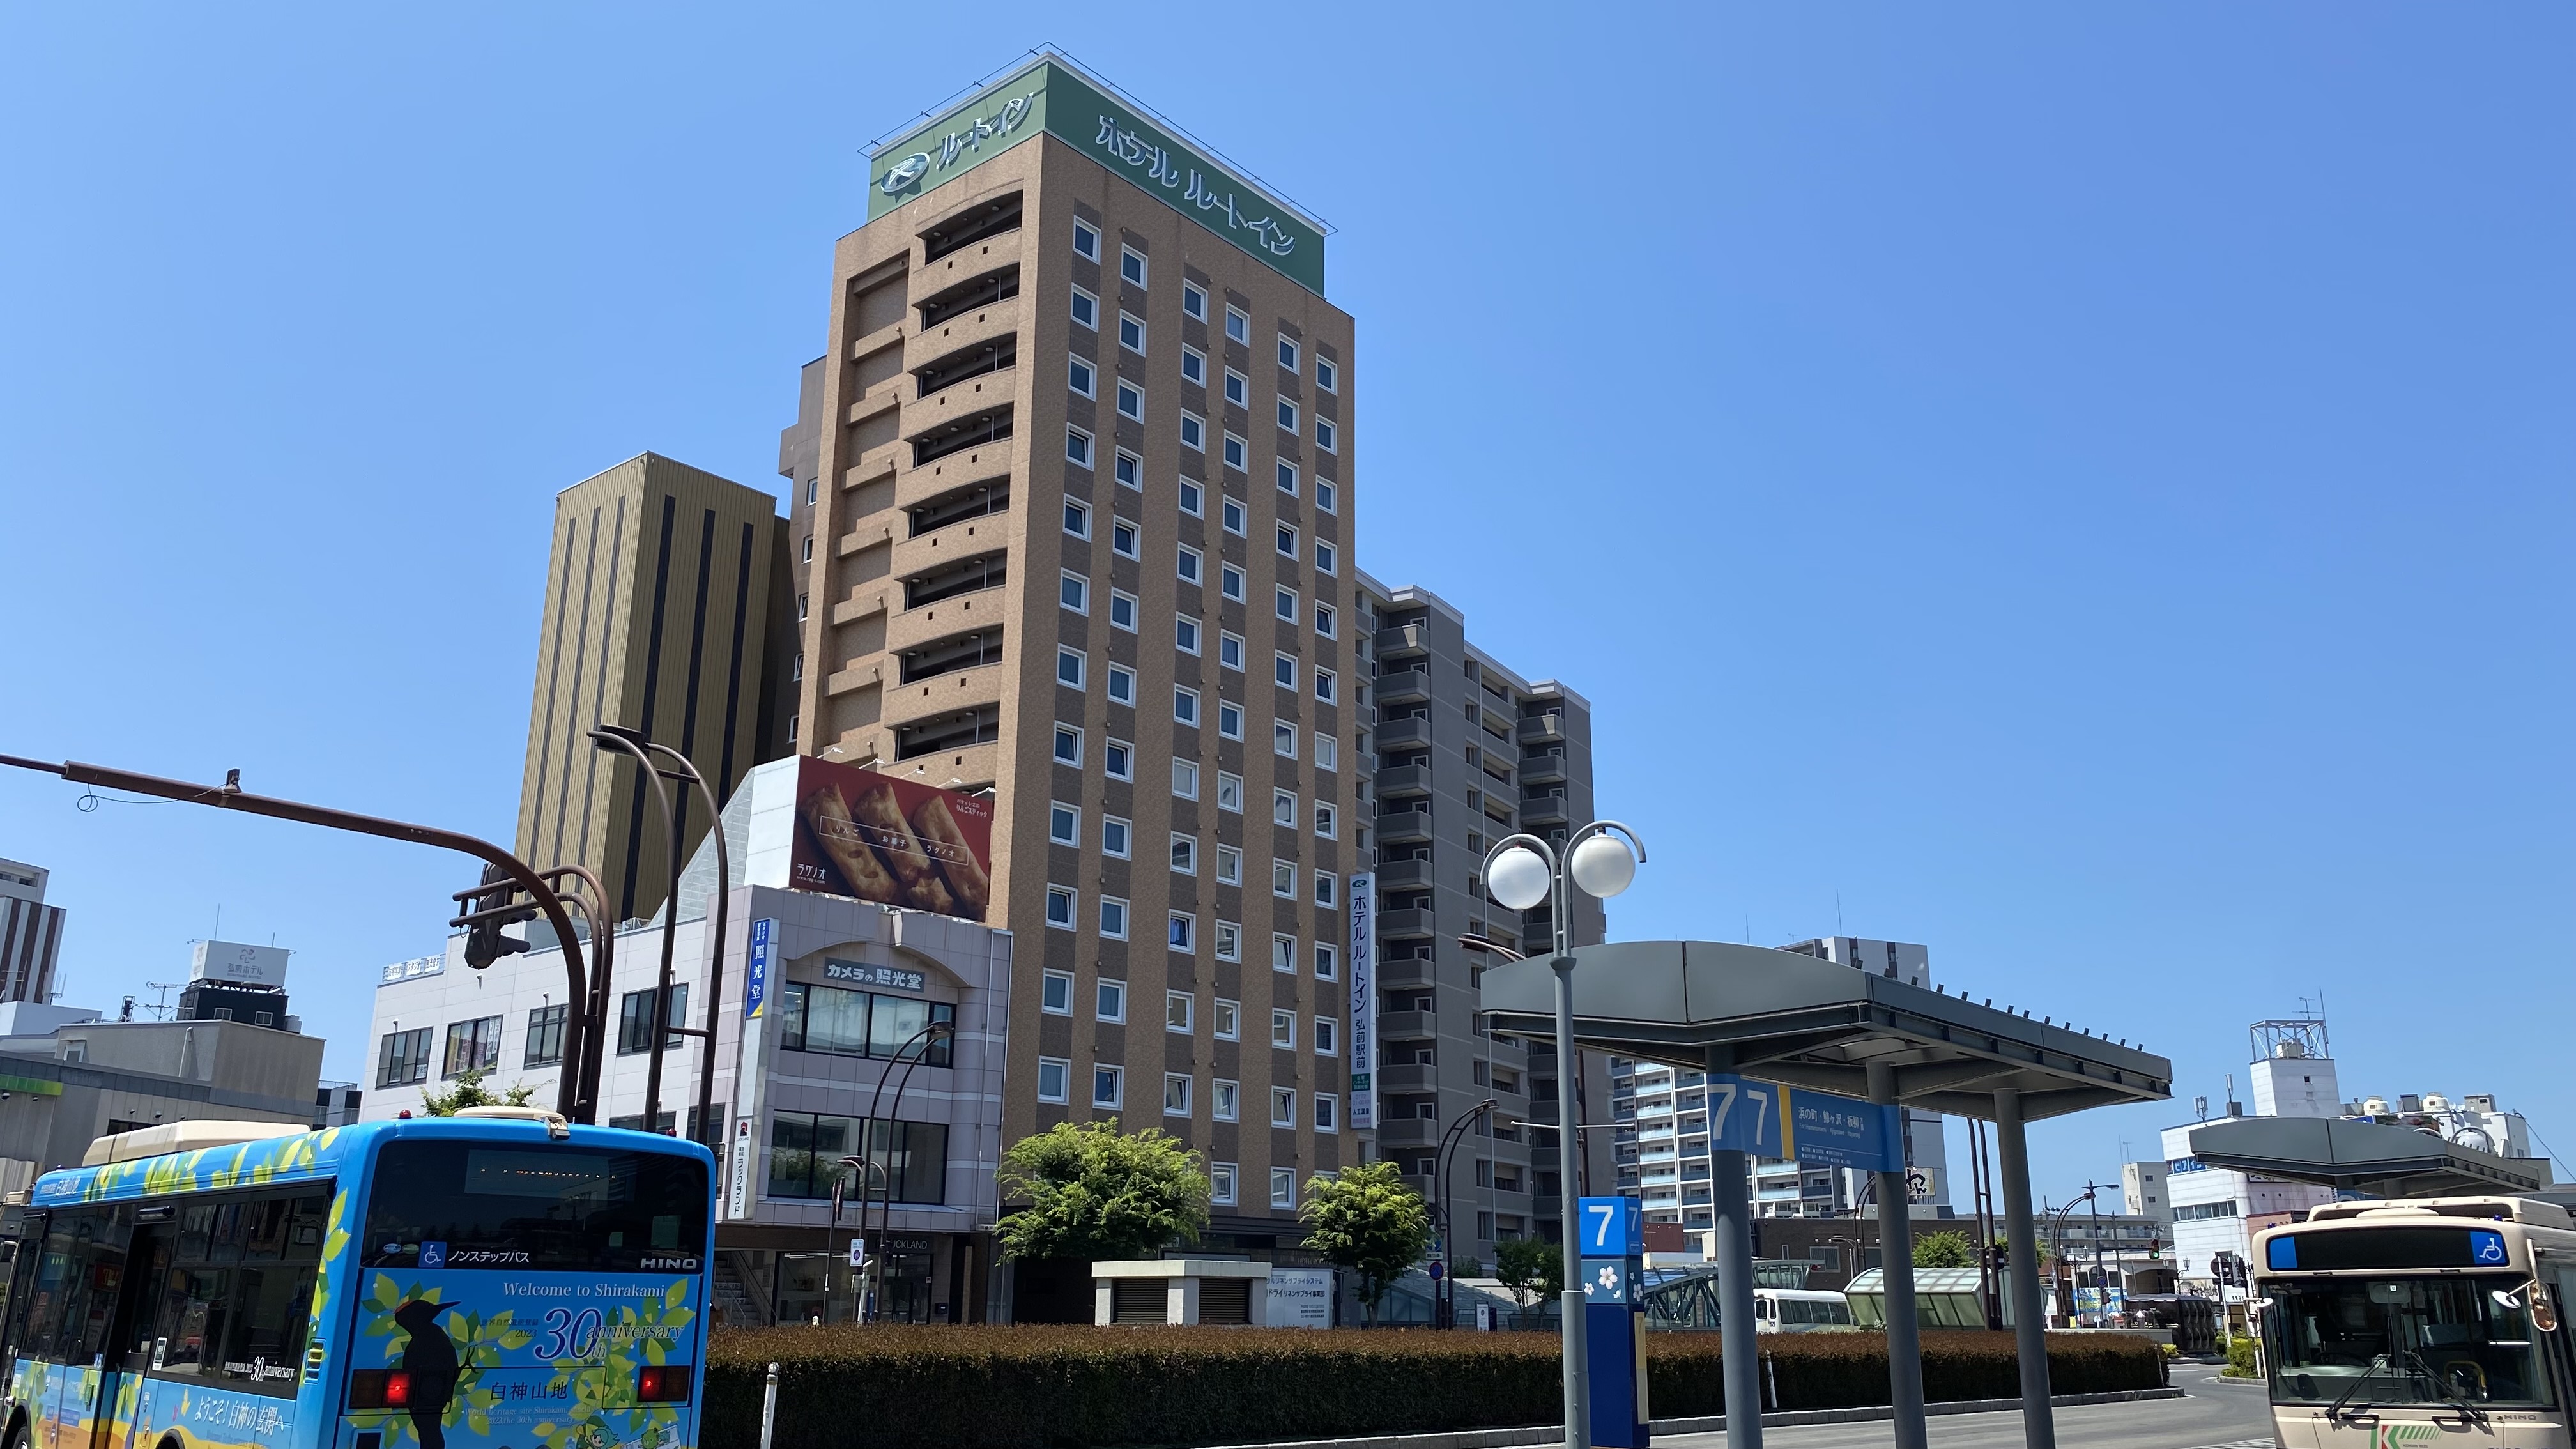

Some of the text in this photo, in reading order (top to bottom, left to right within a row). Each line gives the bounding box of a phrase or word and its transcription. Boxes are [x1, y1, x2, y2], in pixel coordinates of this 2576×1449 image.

[936, 91, 1034, 170] ルートイン
[1096, 114, 1296, 256] ホテル ルートイン
[956, 804, 988, 817] りんごスティック
[836, 825, 859, 836] りんご
[926, 845, 955, 857] ラグノオ
[227, 963, 263, 976] 弘前ホテル
[751, 944, 765, 999] 照光堂
[1353, 896, 1367, 1068] ホテル ルートイン 弘前駅前
[1707, 1083, 1737, 1140] 7
[1747, 1089, 1768, 1146] 7
[734, 1158, 743, 1216] ラックランド
[1588, 1205, 1614, 1246] 7
[1628, 1206, 1638, 1232] 7
[449, 1250, 529, 1262] ノンステップバス
[641, 1258, 697, 1269] HINO
[504, 1282, 665, 1298] Welcome to Shirakami
[515, 1328, 537, 1338] 2023
[535, 1308, 684, 1360] 30 anniversary
[1636, 1316, 1643, 1335] 7
[591, 1343, 606, 1358] th
[250, 1356, 264, 1381] 30
[264, 1365, 295, 1381] anniversary
[490, 1381, 568, 1401] 白神山地
[489, 1407, 517, 1416] heritage
[534, 1406, 569, 1414] Shirakami
[517, 1416, 532, 1424] 30th
[534, 1416, 574, 1424] anniversary
